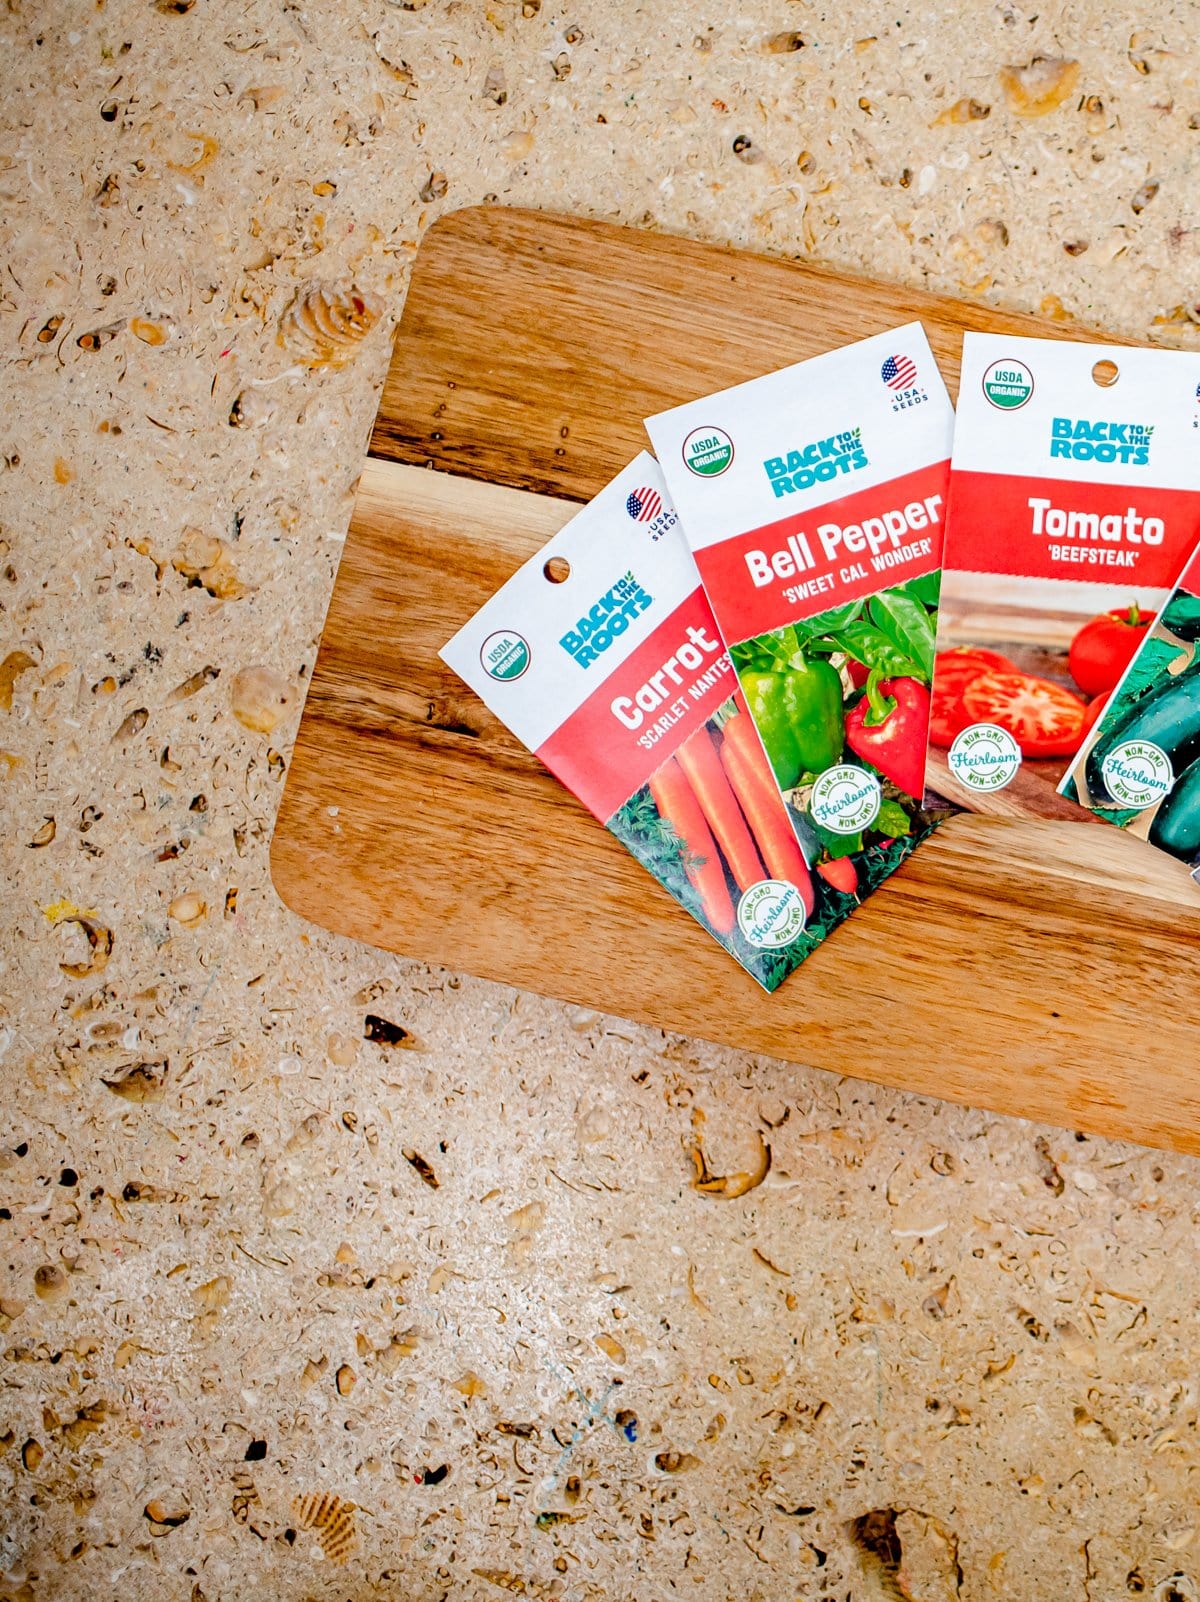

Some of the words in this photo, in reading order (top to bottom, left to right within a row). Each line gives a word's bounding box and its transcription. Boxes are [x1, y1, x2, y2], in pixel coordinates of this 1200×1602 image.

[995, 370, 1023, 383] USDA
[892, 394, 929, 412] SEEDS
[895, 388, 920, 402] USA
[990, 385, 1026, 398] ORGANIC
[836, 431, 852, 444] TO
[1052, 418, 1128, 444] BACK
[1129, 425, 1144, 435] TO
[1129, 435, 1150, 446] THE
[691, 436, 720, 454] USDA
[840, 439, 862, 453] THE
[1050, 439, 1149, 465] ROOTS
[693, 448, 729, 468] ORGANIC
[763, 436, 842, 480] BACK
[771, 448, 869, 498] ROOTS
[650, 512, 670, 530] USA
[1028, 497, 1164, 545] Tomato
[744, 532, 817, 588] Bell
[817, 494, 943, 561] Pepper
[1048, 545, 1139, 567] 'BEEFSTEAK'
[782, 573, 836, 604] 'SWEET
[840, 563, 868, 584] CAL
[870, 538, 932, 573] WONDER'
[559, 589, 625, 655] BACK
[612, 578, 628, 593] TO
[620, 580, 640, 600] THE
[573, 588, 653, 670] ROOTS
[487, 638, 513, 663] USDA
[610, 626, 719, 730] Carrot
[637, 696, 690, 749] 'SCARLET
[963, 730, 1004, 746] NON-GMO
[951, 751, 1018, 768] Heirloom
[1124, 746, 1164, 768] NON-GMO
[819, 771, 855, 796] NON-GMO
[967, 769, 1007, 785] NON-GMO
[1107, 759, 1168, 791] Heirloom
[815, 783, 877, 820] Heirloom
[1113, 782, 1152, 803] NON-GMO
[838, 802, 874, 828] NON-GMO
[745, 886, 771, 920] NON-GMO
[750, 889, 796, 942] Heirloom
[775, 907, 800, 941] NON-GMO
